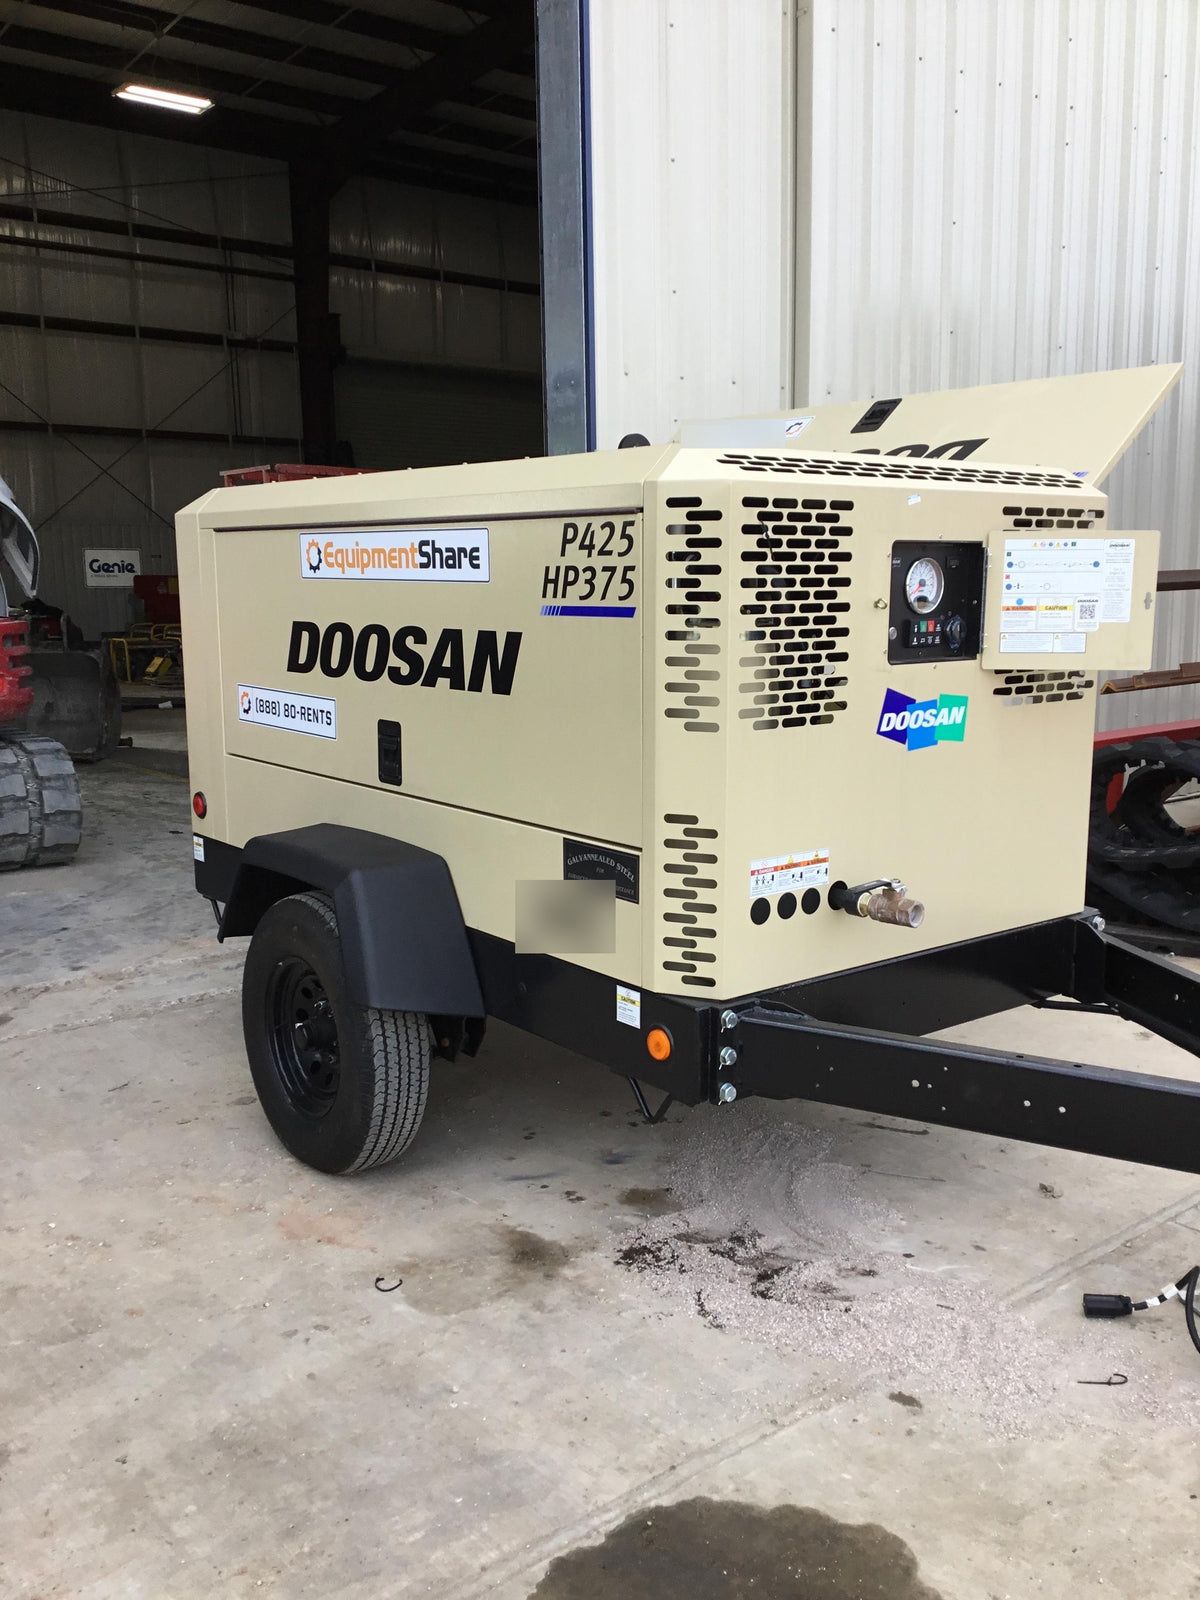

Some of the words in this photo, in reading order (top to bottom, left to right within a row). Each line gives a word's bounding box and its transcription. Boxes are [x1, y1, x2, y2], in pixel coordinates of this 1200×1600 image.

[560, 519, 636, 558] P425
[89, 558, 136, 573] Genie
[323, 540, 481, 574] EquipmentShare
[542, 564, 636, 601] HP375
[287, 621, 523, 696] DOOSAN
[255, 697, 281, 717] (888)
[283, 703, 333, 727] 80-RENTS
[880, 706, 965, 732] DOOSAN
[567, 853, 616, 867] GALVANNEALED
[616, 862, 635, 883] STEEL
